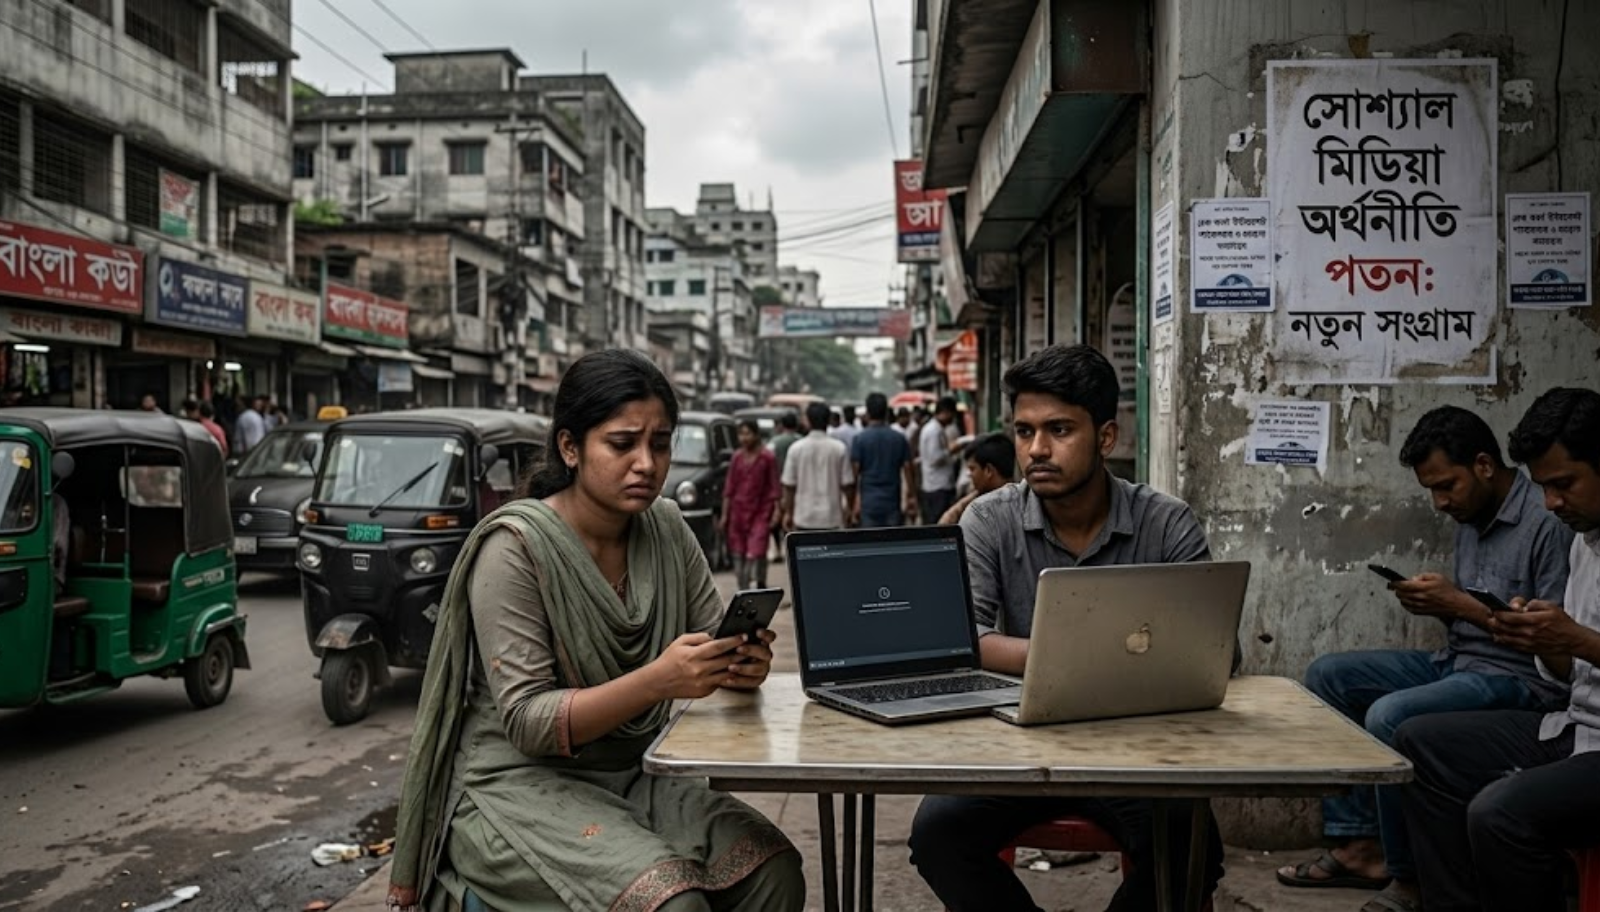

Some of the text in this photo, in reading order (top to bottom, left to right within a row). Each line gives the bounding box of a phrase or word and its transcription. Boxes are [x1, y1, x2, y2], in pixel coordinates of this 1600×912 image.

[1304, 87, 1458, 130] সোশ্যাল
[1313, 135, 1446, 186] মিডিয়া
[1298, 189, 1462, 242] অর্থনীতি
[1325, 254, 1434, 296] পতন:
[1288, 307, 1477, 350] নতুন সংগ্রাম
